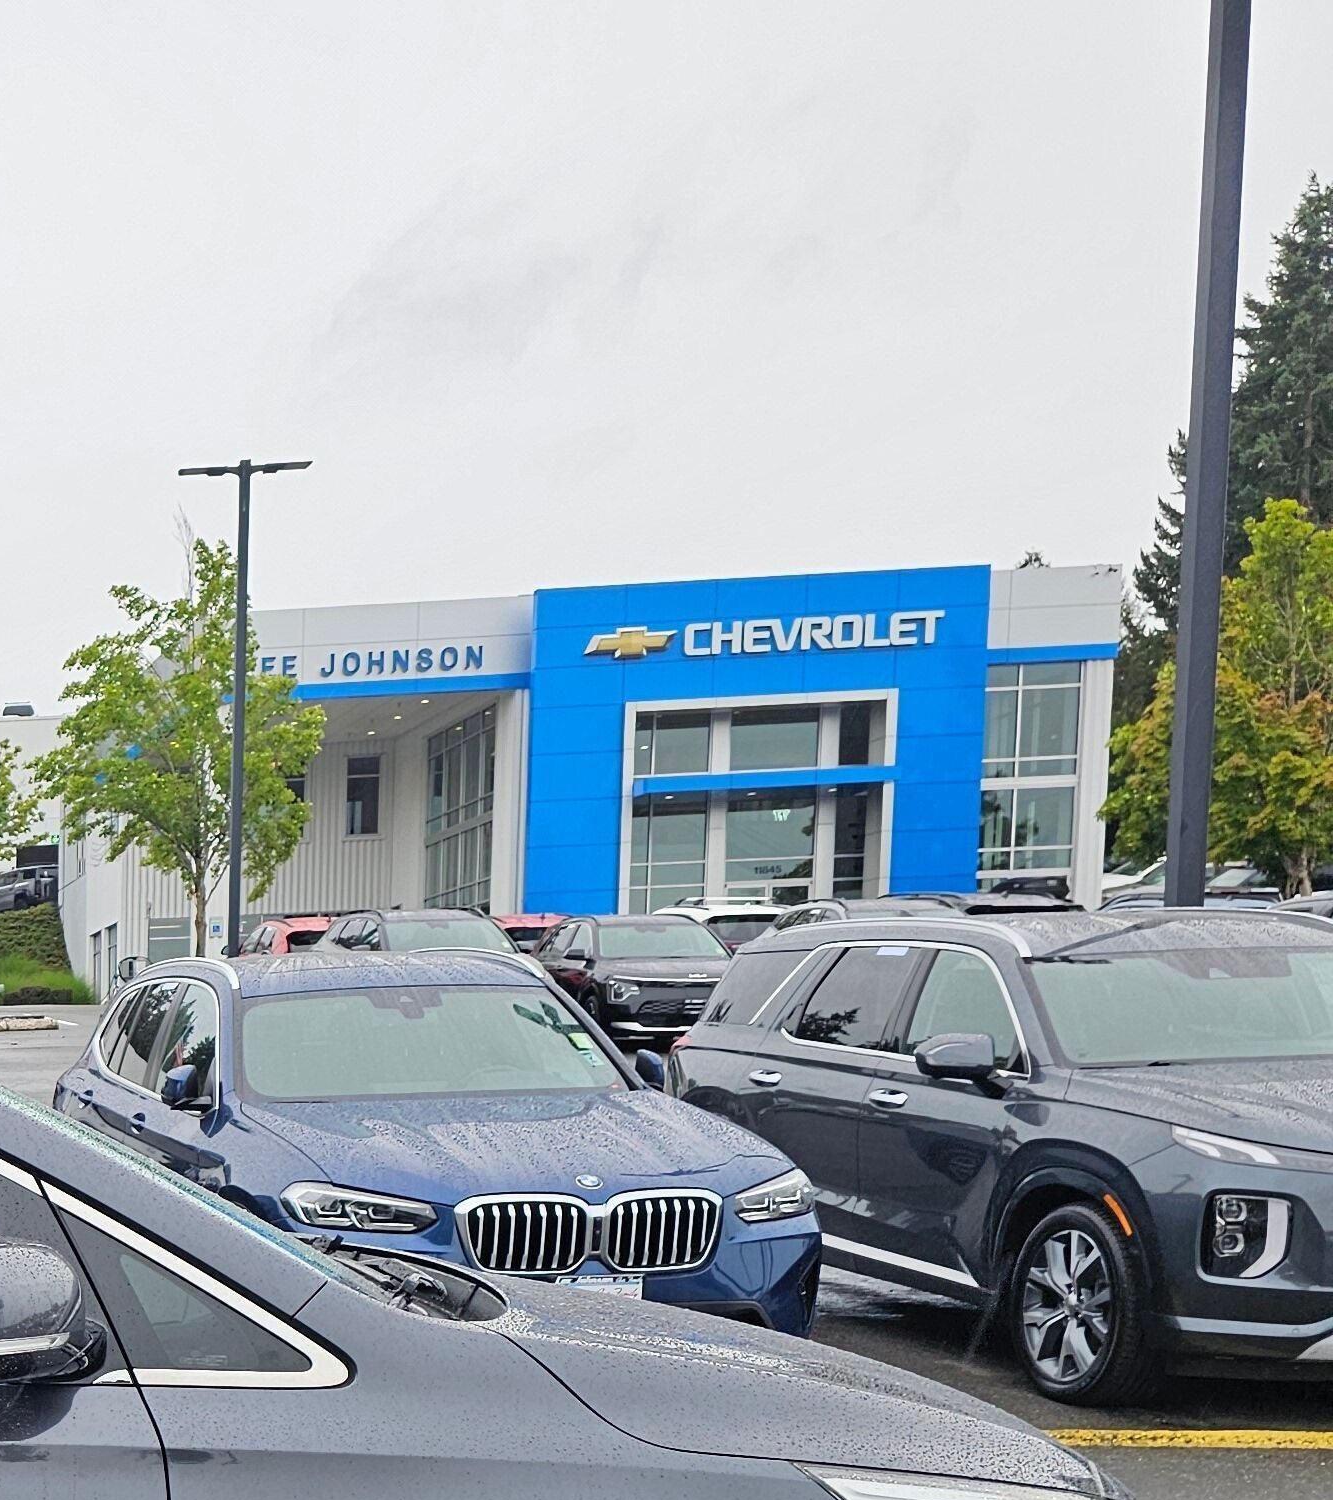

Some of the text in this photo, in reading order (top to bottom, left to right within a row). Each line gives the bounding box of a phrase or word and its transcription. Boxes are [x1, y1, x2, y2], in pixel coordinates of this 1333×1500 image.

[684, 609, 946, 656] CHEVROLET
[259, 645, 484, 678] EE JOHNSON
